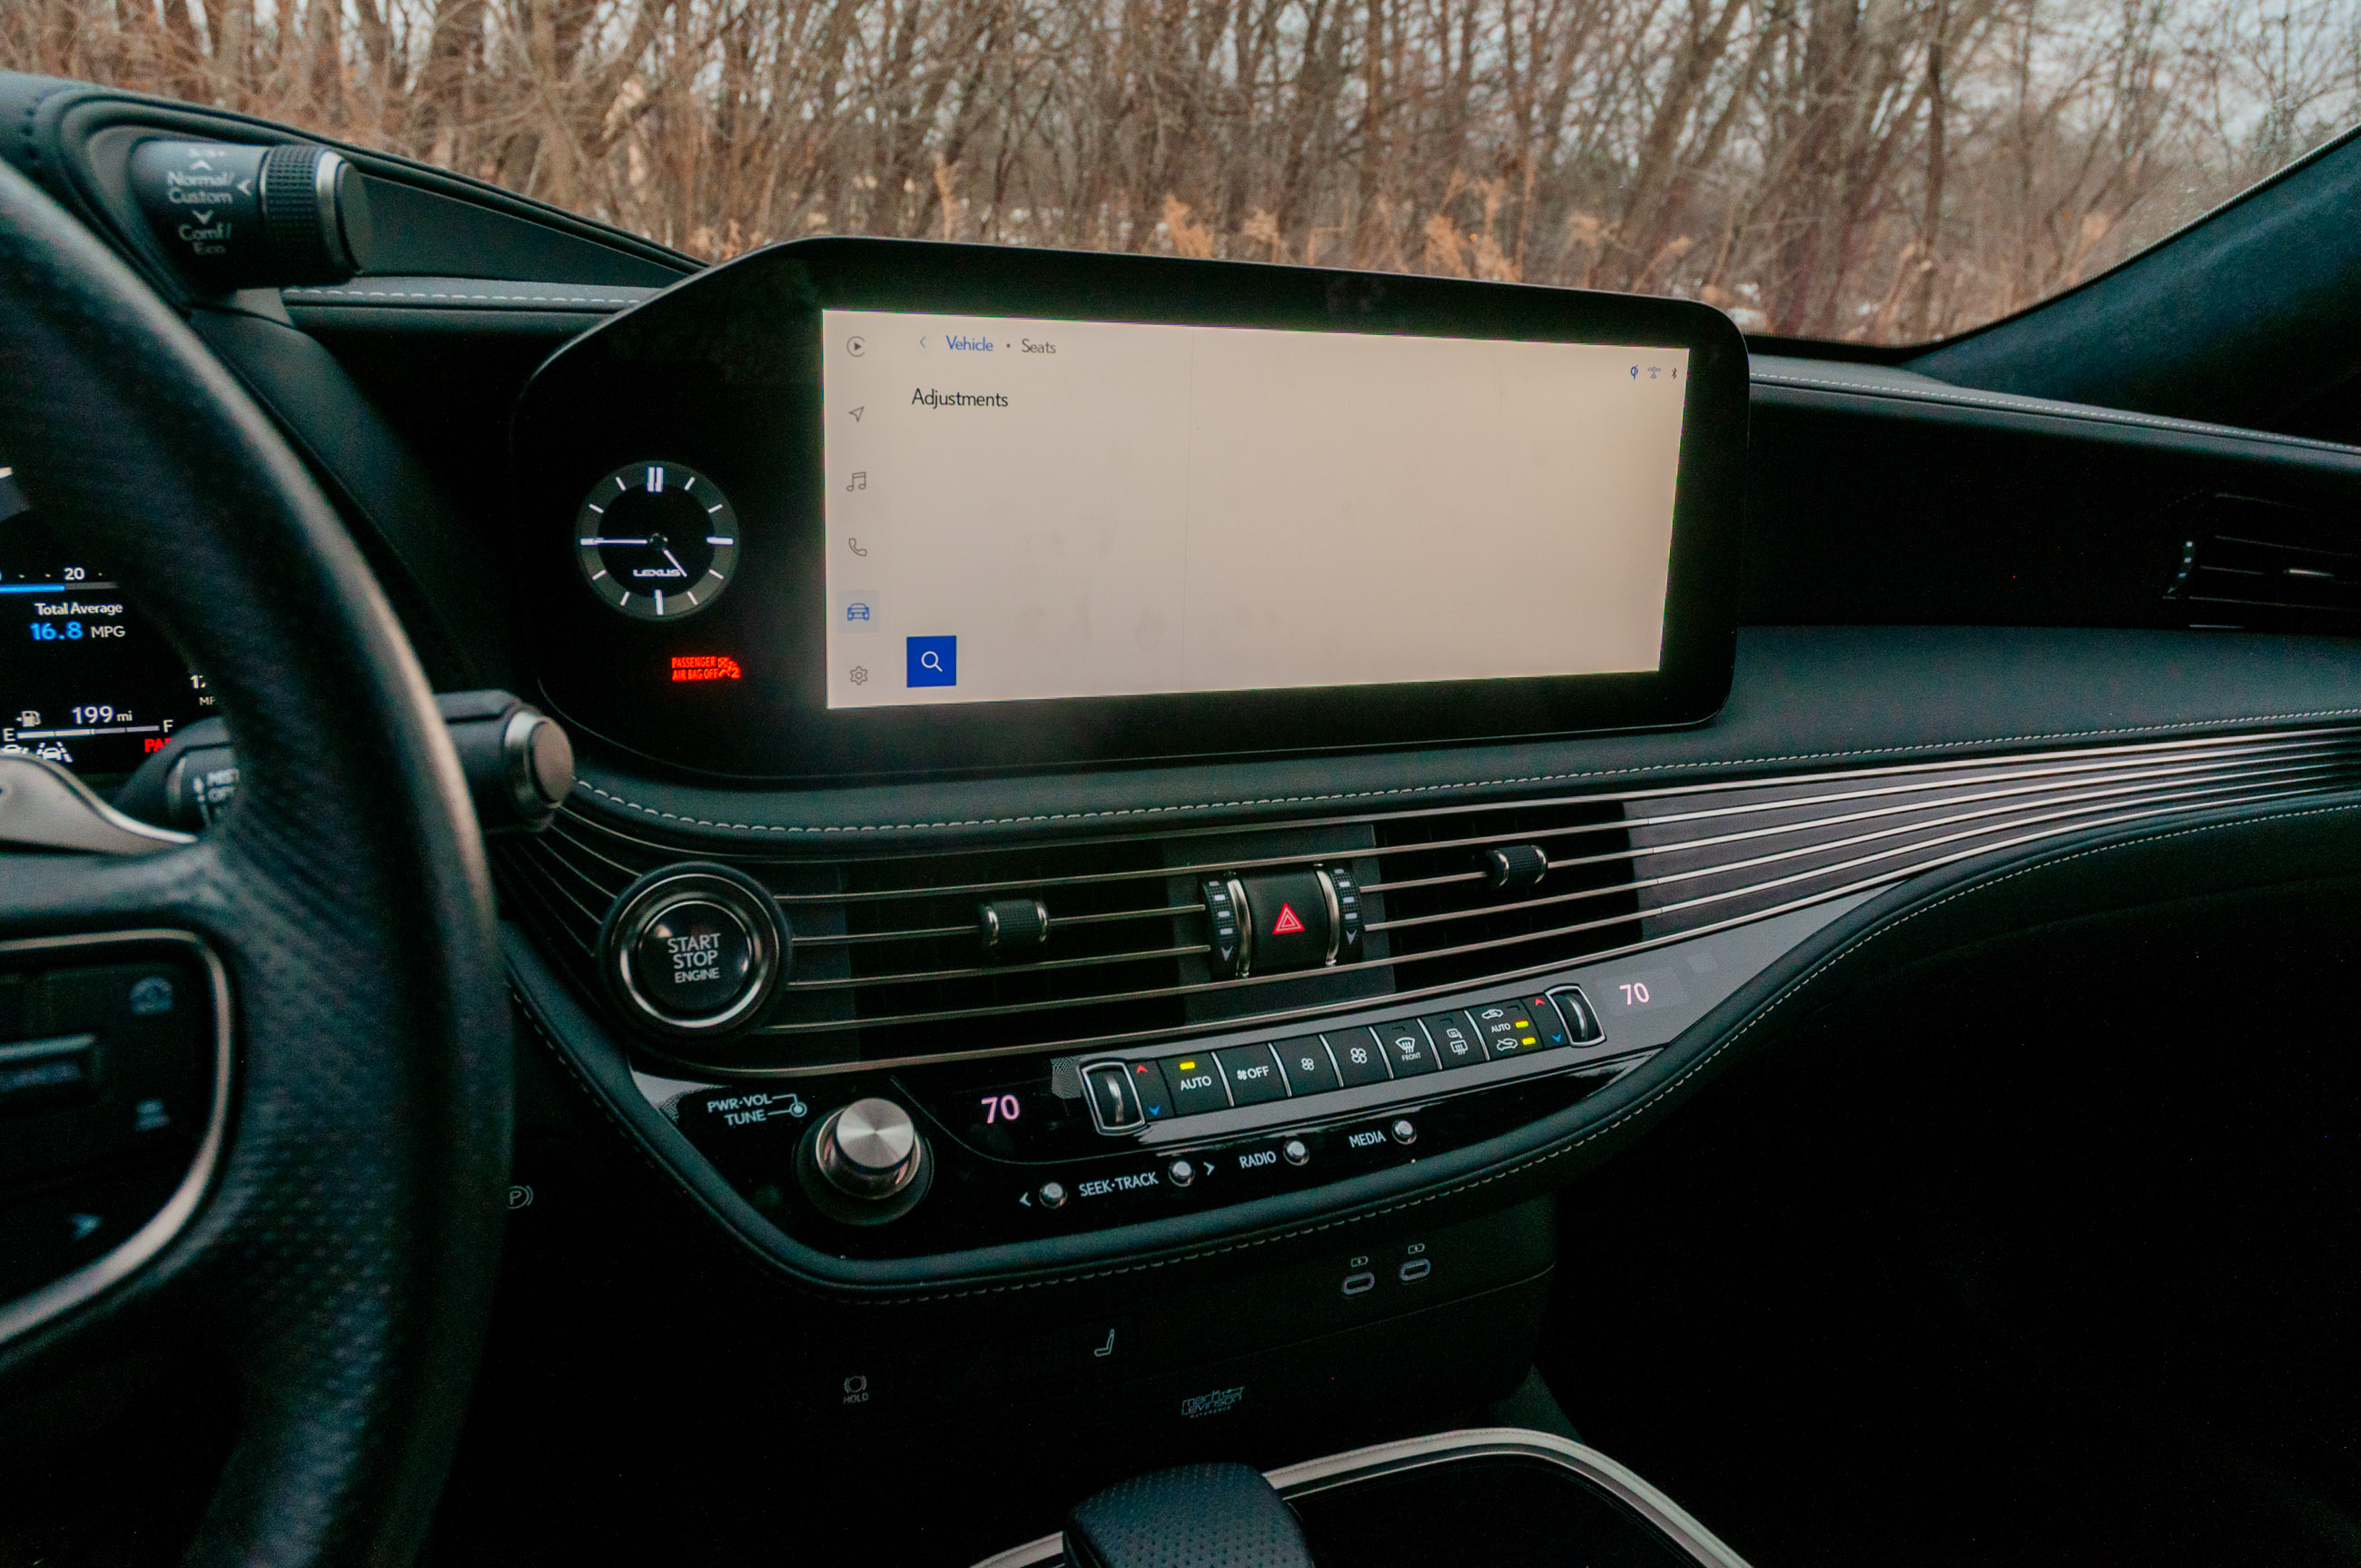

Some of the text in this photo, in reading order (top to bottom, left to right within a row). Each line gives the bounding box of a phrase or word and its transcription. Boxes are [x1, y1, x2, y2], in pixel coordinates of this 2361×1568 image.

[945, 335, 1056, 354] Vehicle Seats
[911, 387, 1008, 409] Adjustments
[64, 567, 85, 580] 20
[633, 568, 681, 577] LEXUS
[34, 602, 123, 616] Total Average
[30, 621, 126, 641] 16.8 MPG
[671, 656, 717, 669] PASSENGER
[672, 668, 687, 681] AIR
[687, 668, 704, 681] BAG
[704, 667, 719, 679] OFF
[72, 705, 133, 725] 199 mi
[163, 719, 173, 733] F
[3, 727, 15, 742] E
[667, 932, 721, 953] START
[672, 950, 719, 969] STOP
[674, 967, 720, 983] ENGINE
[1619, 982, 1650, 1005] 70
[1490, 1021, 1512, 1032] AUTO
[1401, 1050, 1421, 1062] FRONT
[1246, 1065, 1269, 1080] OFF
[1180, 1075, 1212, 1090] AUTO
[981, 1094, 1021, 1124] 70
[724, 1109, 767, 1126] TUNE
[1348, 1129, 1387, 1149] MEDIA
[1239, 1150, 1277, 1169] RADIO
[842, 1392, 869, 1405] HOLD
